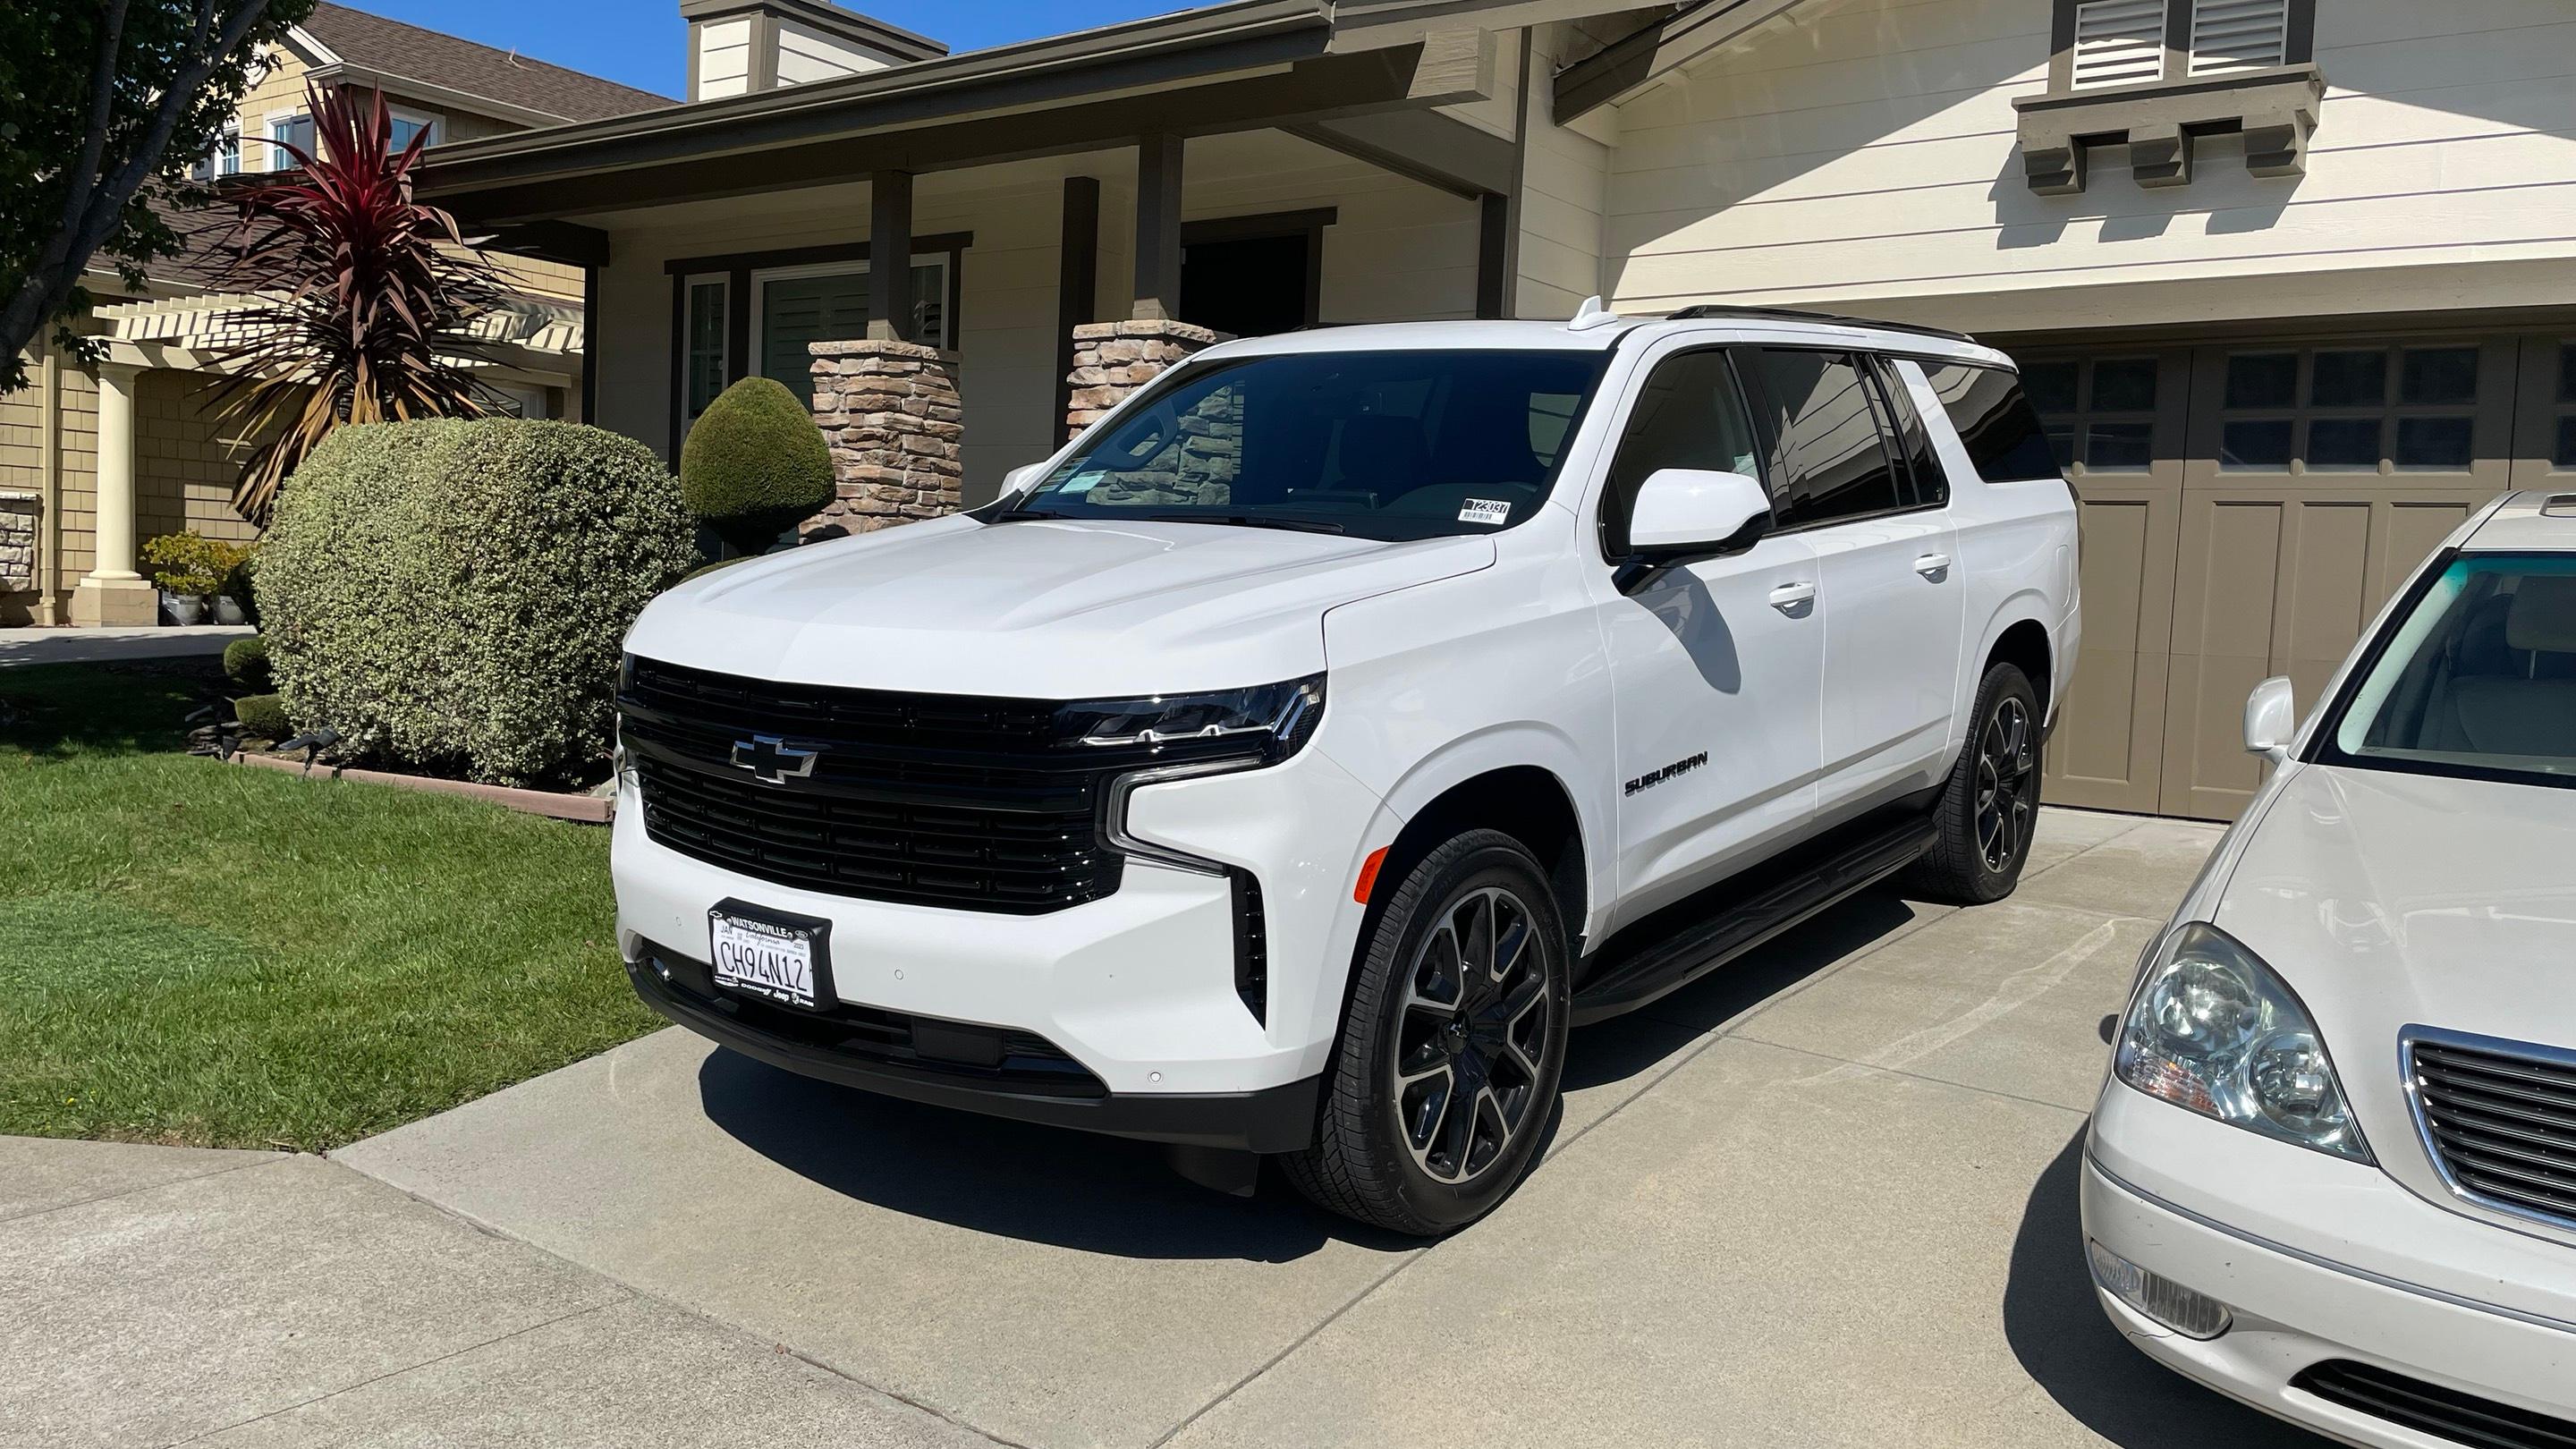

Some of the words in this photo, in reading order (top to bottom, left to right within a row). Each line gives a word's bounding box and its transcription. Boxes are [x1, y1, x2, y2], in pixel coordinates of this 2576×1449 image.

[1624, 751, 1707, 794] SUBURBAN
[731, 916, 787, 937] WATSONVILLE
[746, 930, 780, 945] California
[721, 941, 807, 992] CH94N12
[774, 989, 789, 1002] Jeep
